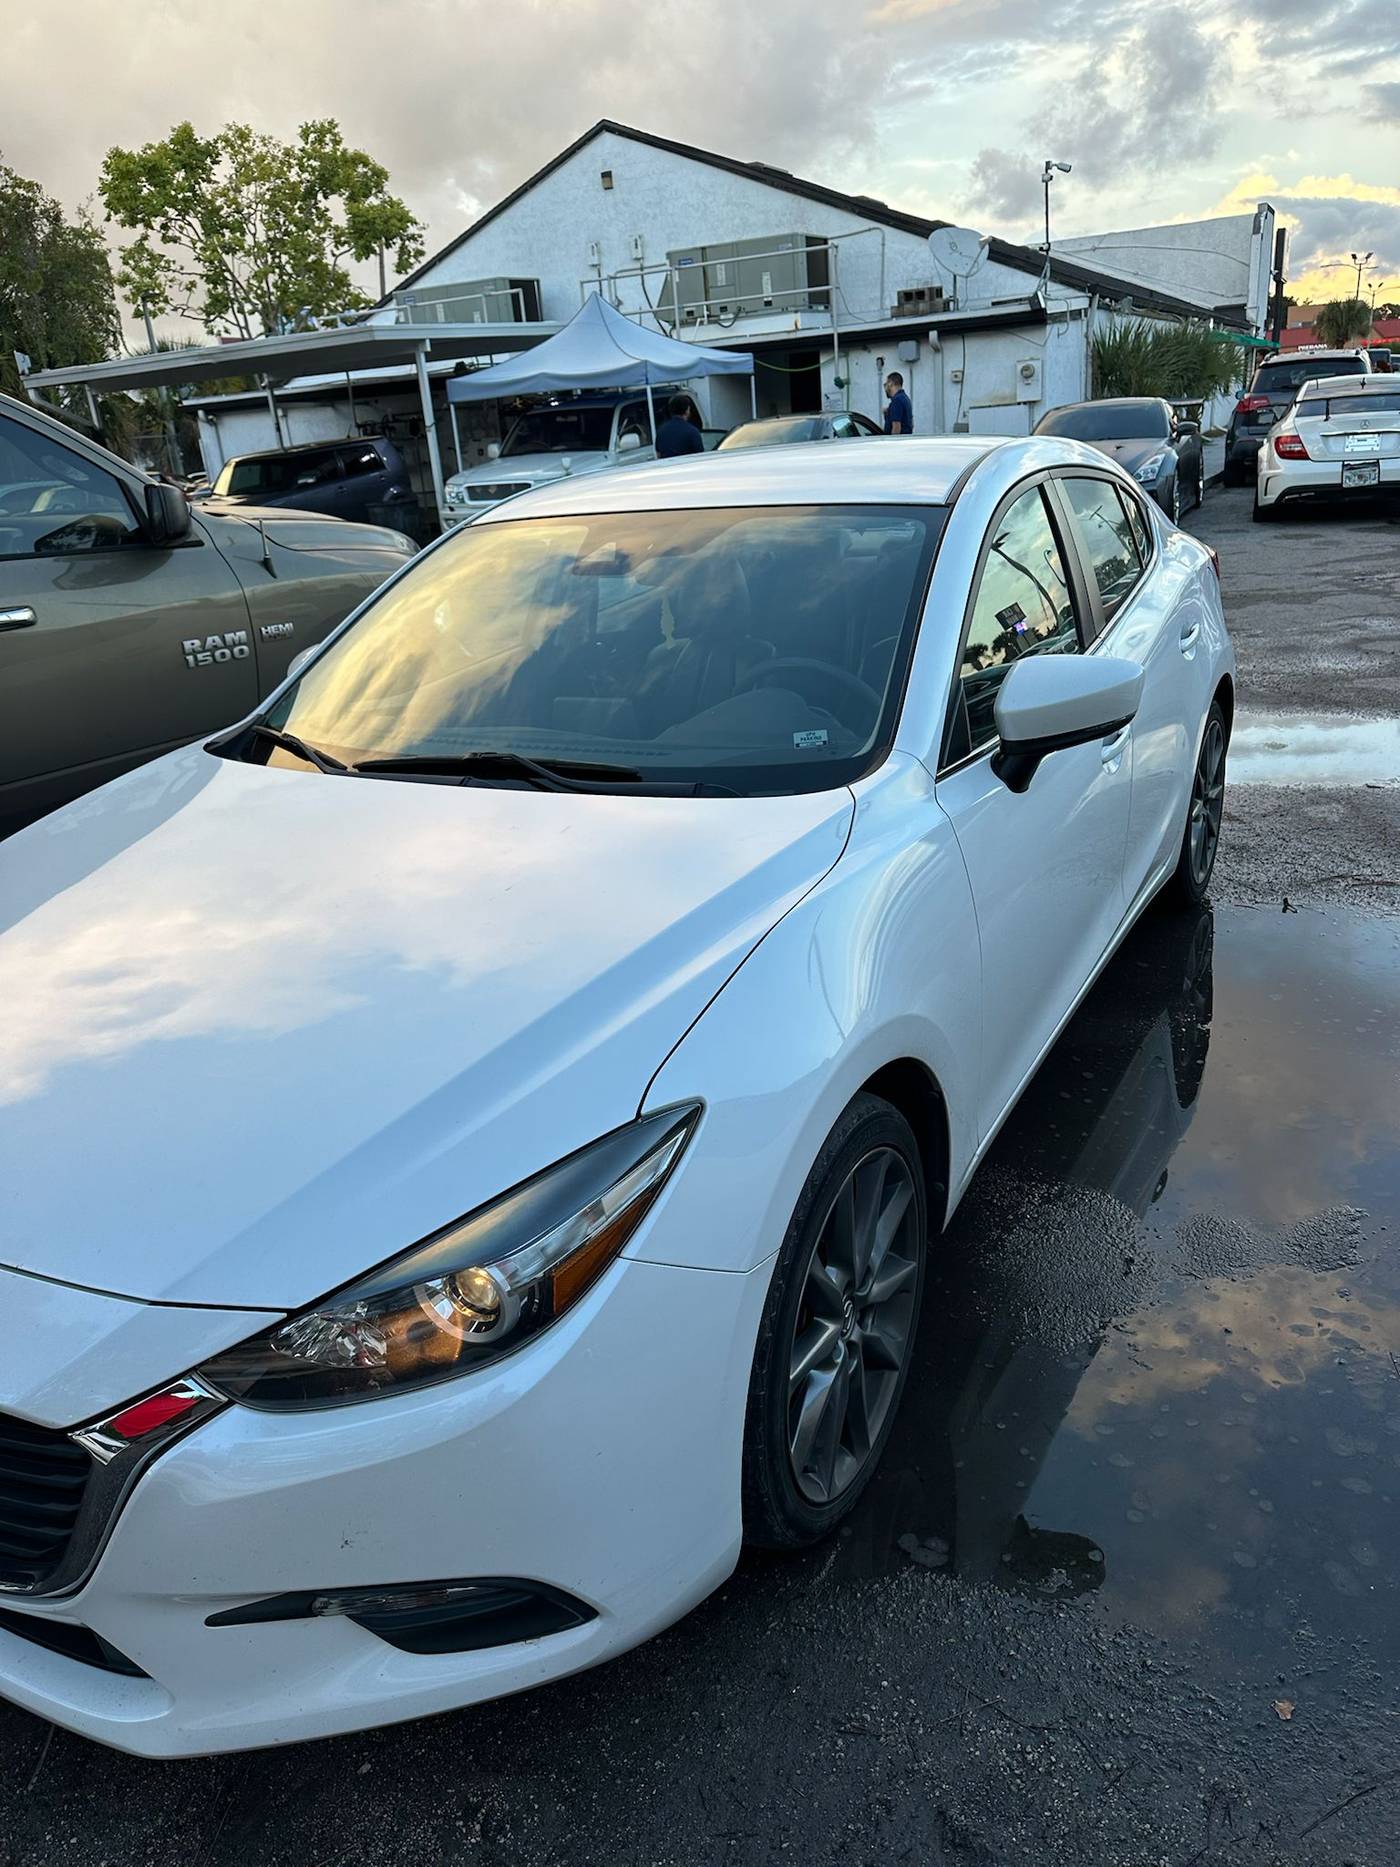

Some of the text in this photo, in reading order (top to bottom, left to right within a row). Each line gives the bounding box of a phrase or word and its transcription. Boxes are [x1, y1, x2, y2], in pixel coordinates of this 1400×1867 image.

[260, 622, 294, 635] HEMI
[182, 630, 248, 654] RAM
[185, 645, 250, 668] 1500
